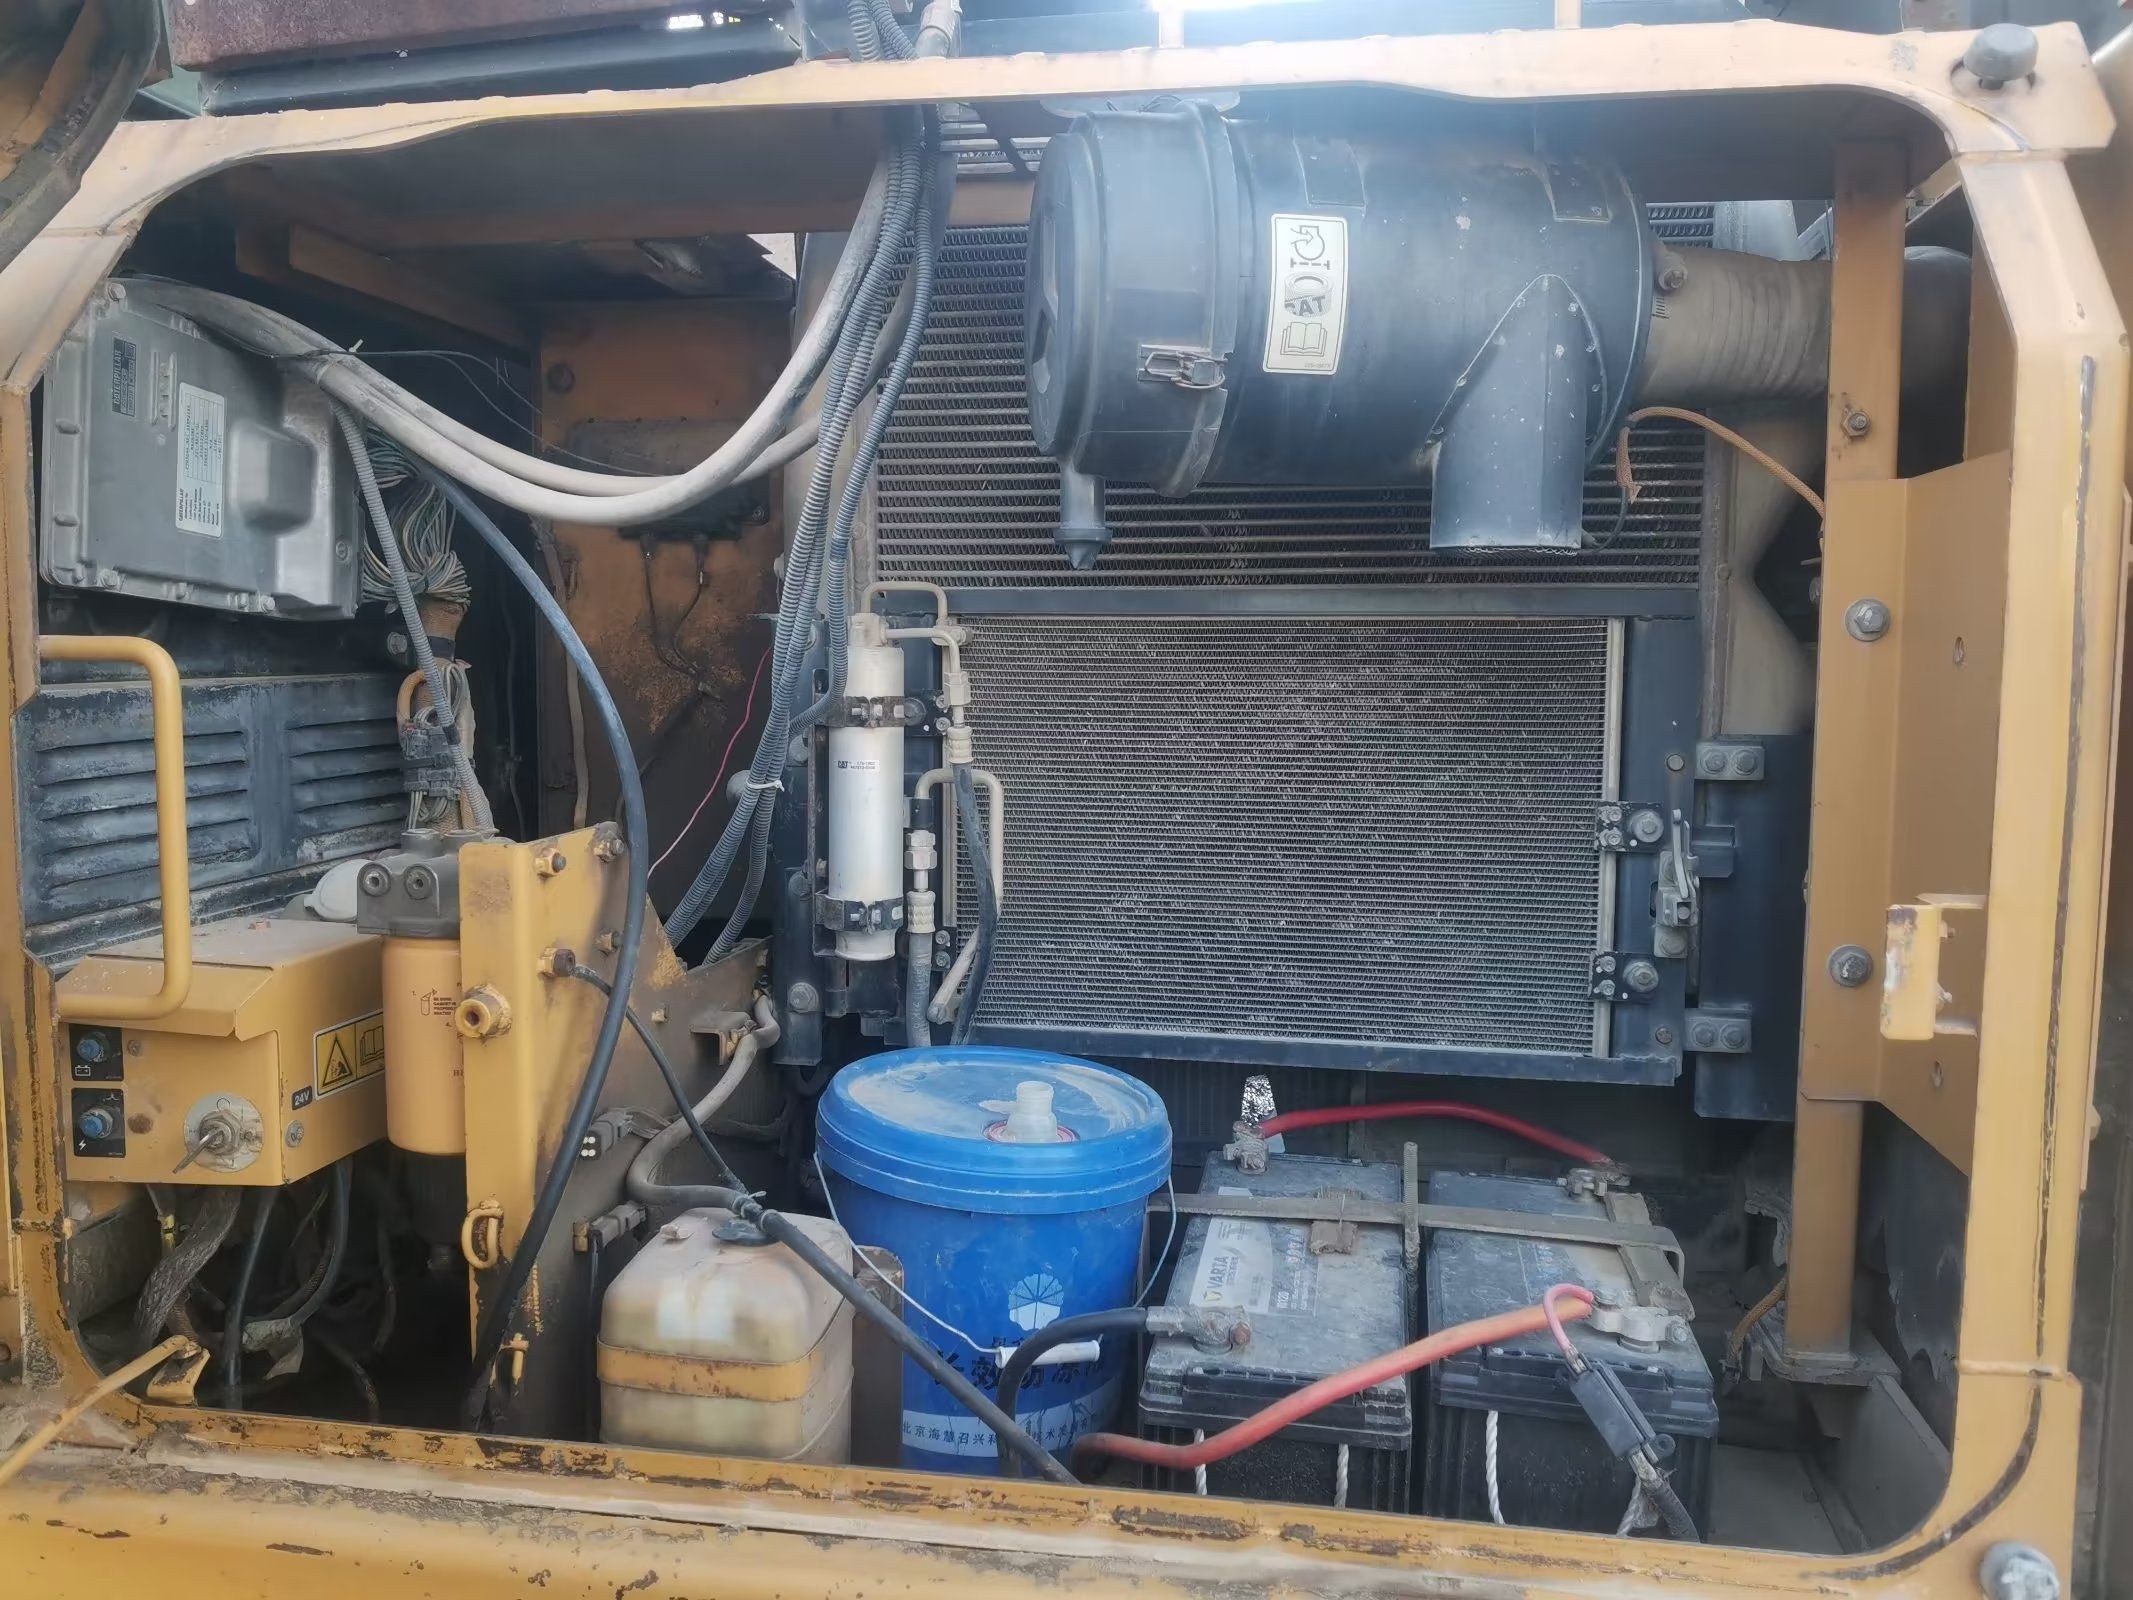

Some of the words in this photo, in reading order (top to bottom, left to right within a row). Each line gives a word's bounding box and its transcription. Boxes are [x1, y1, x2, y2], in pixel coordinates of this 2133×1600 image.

[113, 349, 122, 405] CATERPILLAR
[837, 760, 848, 769] CAT
[294, 1090, 310, 1106] 24V
[1206, 1256, 1229, 1289] VARTA
